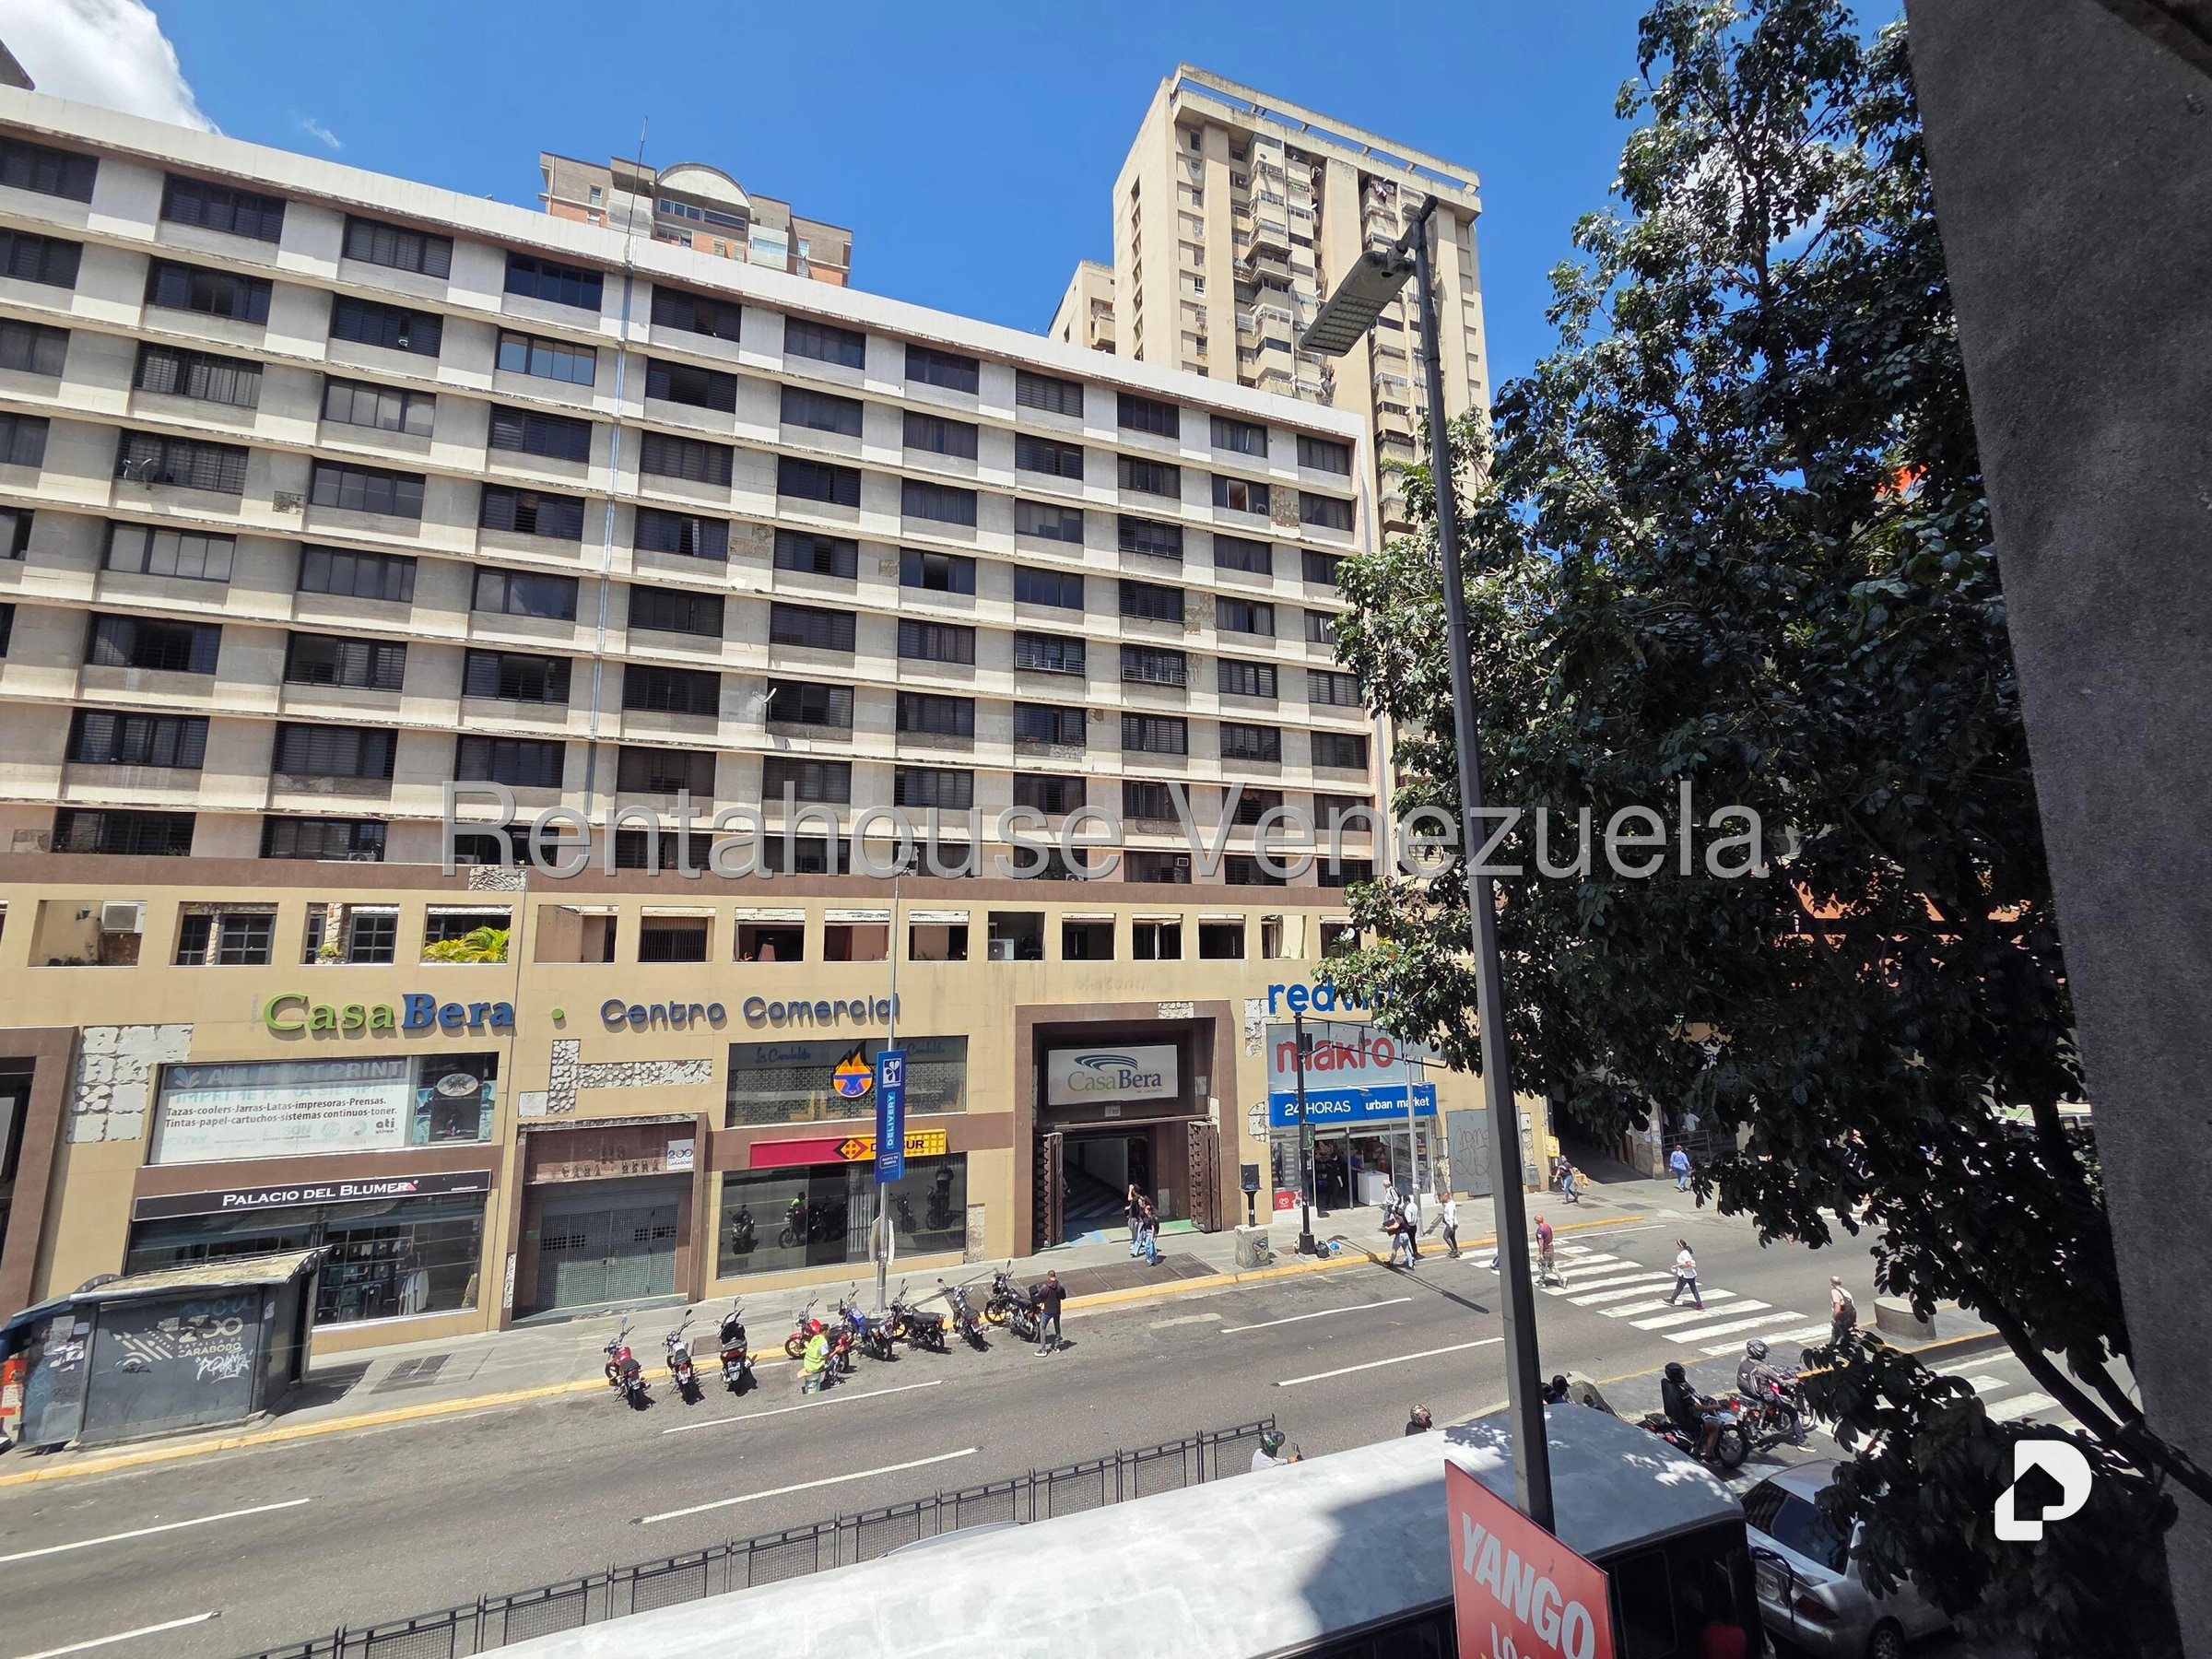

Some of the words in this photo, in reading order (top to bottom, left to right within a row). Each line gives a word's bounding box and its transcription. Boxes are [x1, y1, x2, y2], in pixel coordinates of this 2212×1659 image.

[263, 993, 514, 1030] CasaBera
[600, 998, 726, 1023] Centro
[743, 993, 900, 1019] Comercial
[1277, 1037, 1395, 1073] makro
[329, 1060, 404, 1078] PRINT
[1067, 1069, 1163, 1092] CasaBera
[1305, 1100, 1351, 1114] HORAS
[1365, 1100, 1393, 1111] urban
[1396, 1096, 1430, 1109] maket
[887, 1095, 895, 1147] DELIVERY
[222, 1192, 300, 1206] PALACIO
[303, 1188, 335, 1200] DEL
[1463, 1512, 1595, 1659] YANGO
